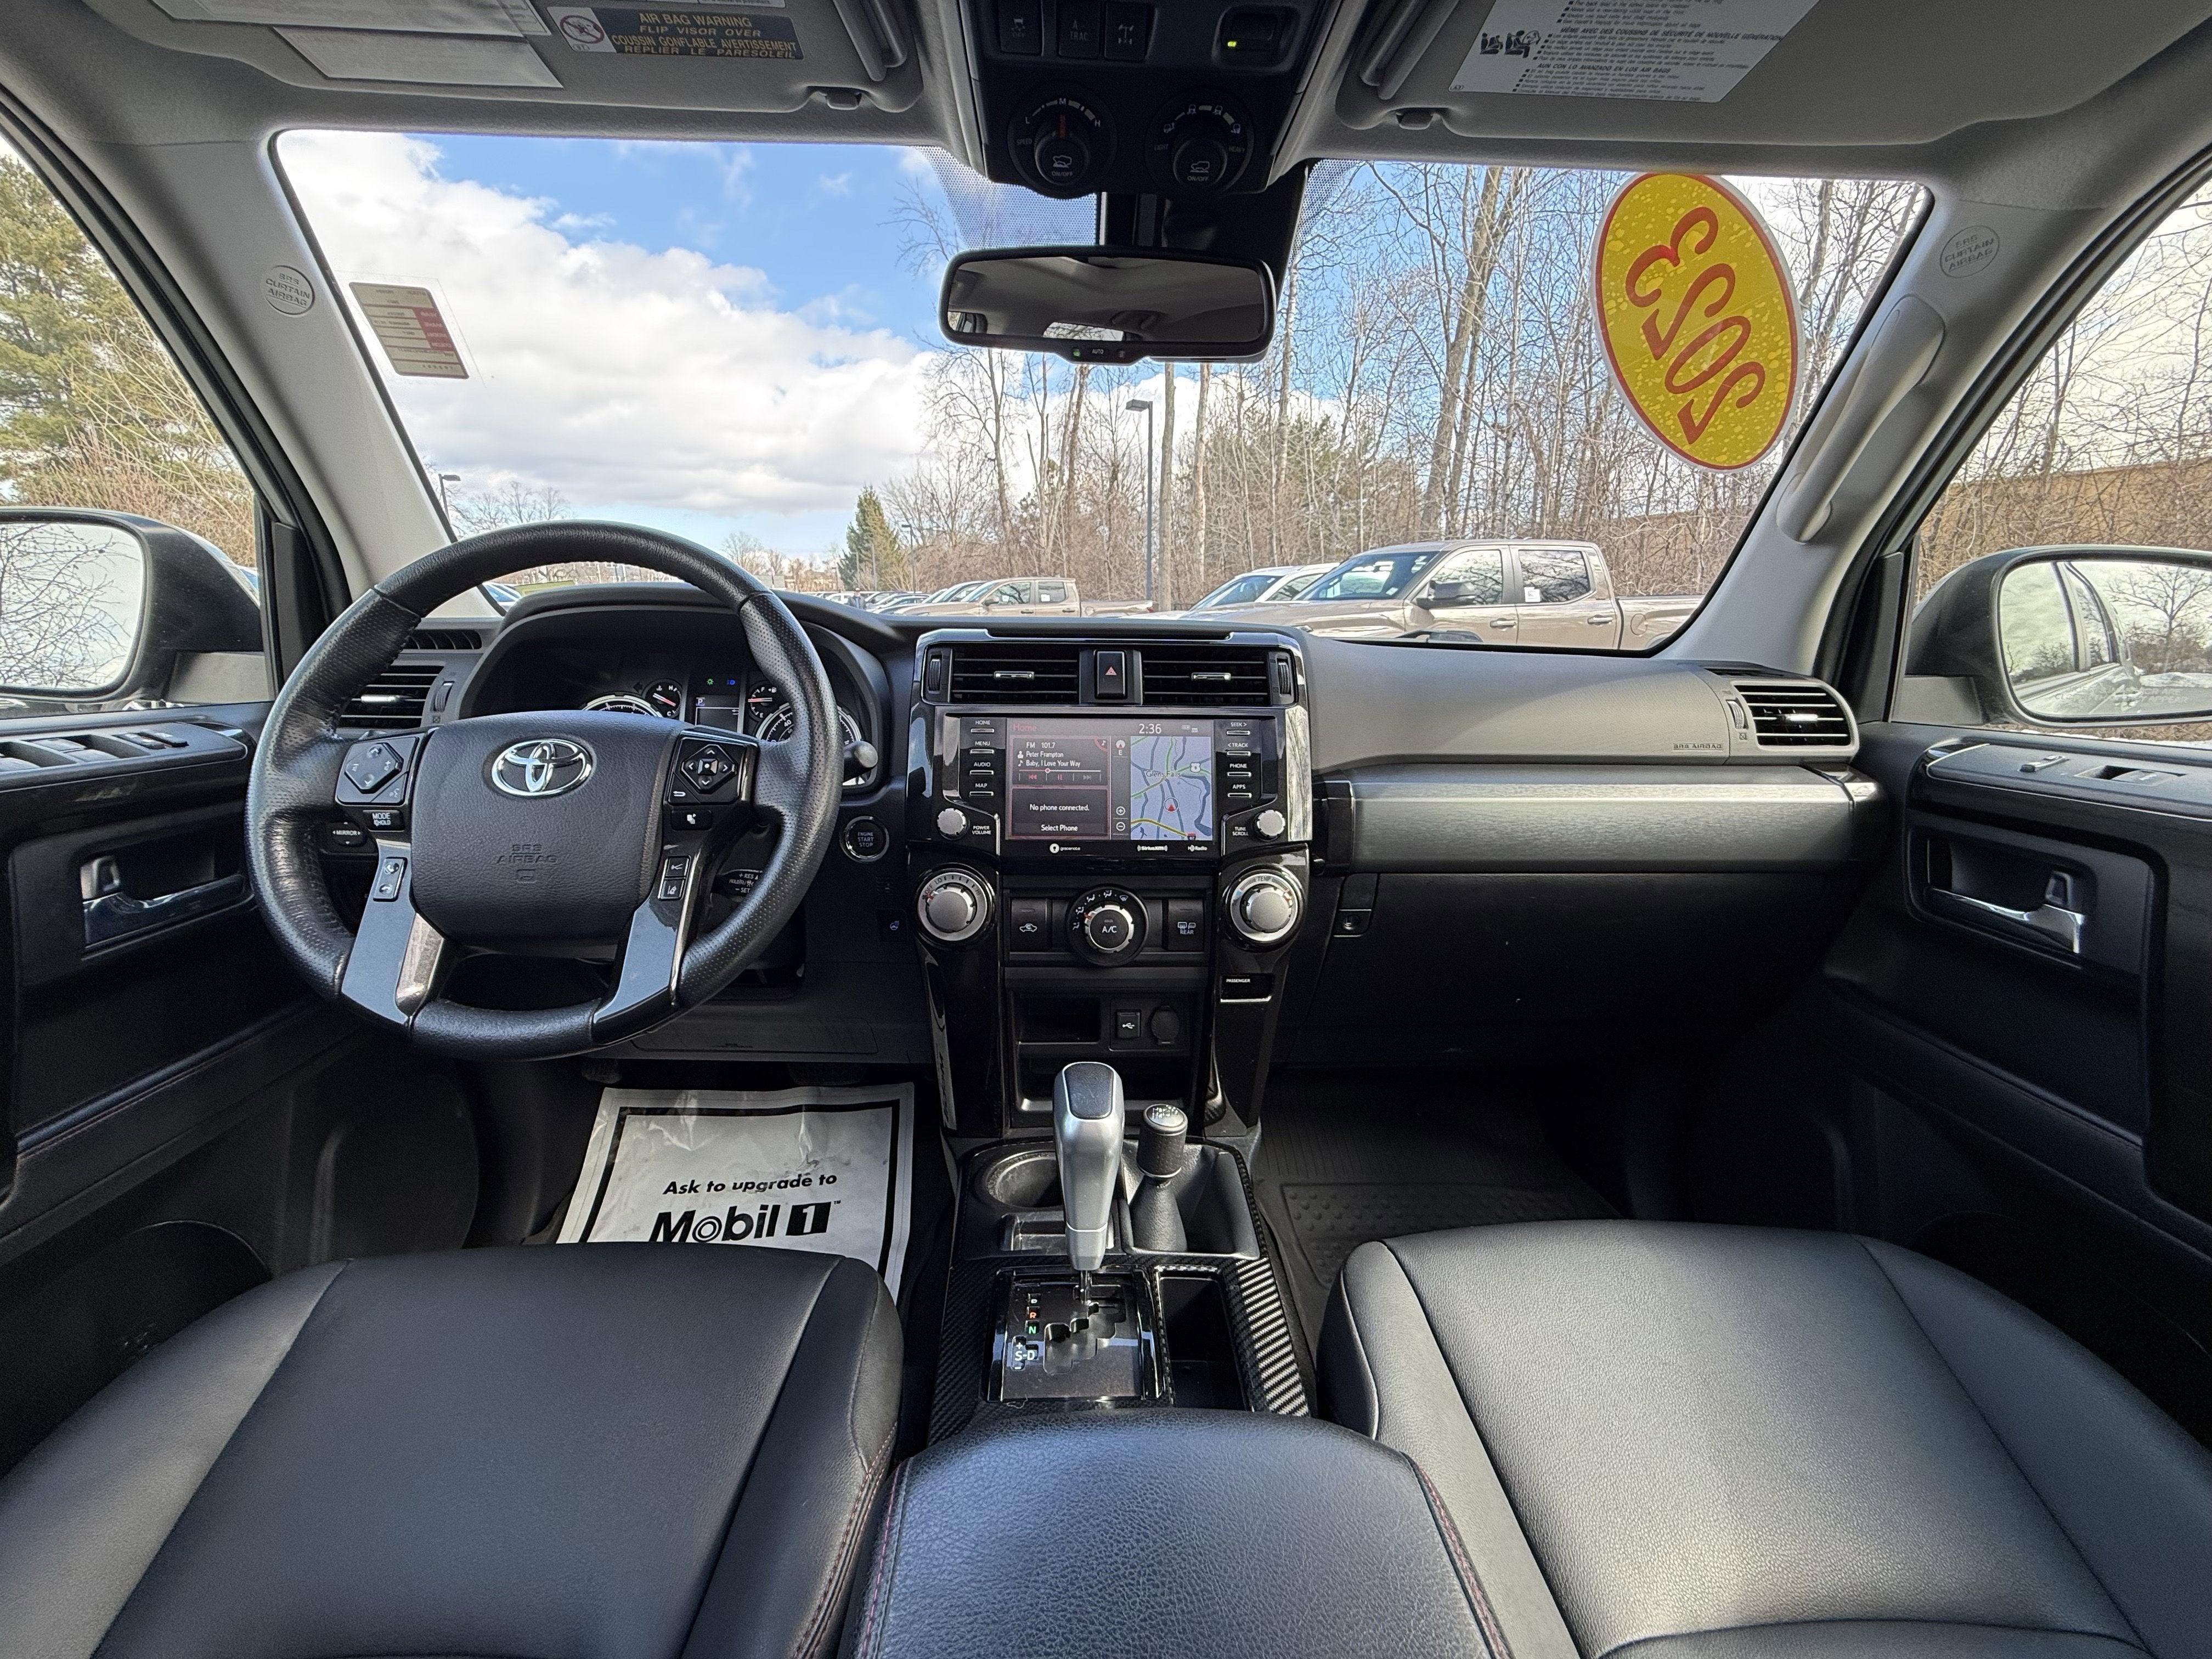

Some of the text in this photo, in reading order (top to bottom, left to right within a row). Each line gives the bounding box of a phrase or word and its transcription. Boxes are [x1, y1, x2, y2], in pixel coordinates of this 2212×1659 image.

[639, 13, 752, 27] AIR BAG WARNING
[640, 26, 760, 37] FLIP VISOR OVER
[1070, 31, 1089, 41] TRAC
[611, 35, 796, 52] COUSSIN GONFLABLE AVERTISSEMENT
[624, 46, 795, 59] REPLIER LE PARESOLEIL
[1094, 120, 1101, 128] H
[1945, 238, 1994, 262] CURTAIN
[1949, 248, 1993, 270] AIRBAG
[279, 273, 299, 285] SRS
[266, 278, 310, 299] CURTAIN
[268, 289, 307, 306] AIRBAG
[1139, 724, 1161, 733] 2:36
[924, 883, 933, 894] OFF
[663, 1174, 837, 1194] Ask to upgrade to
[648, 1204, 781, 1243] Mobil
